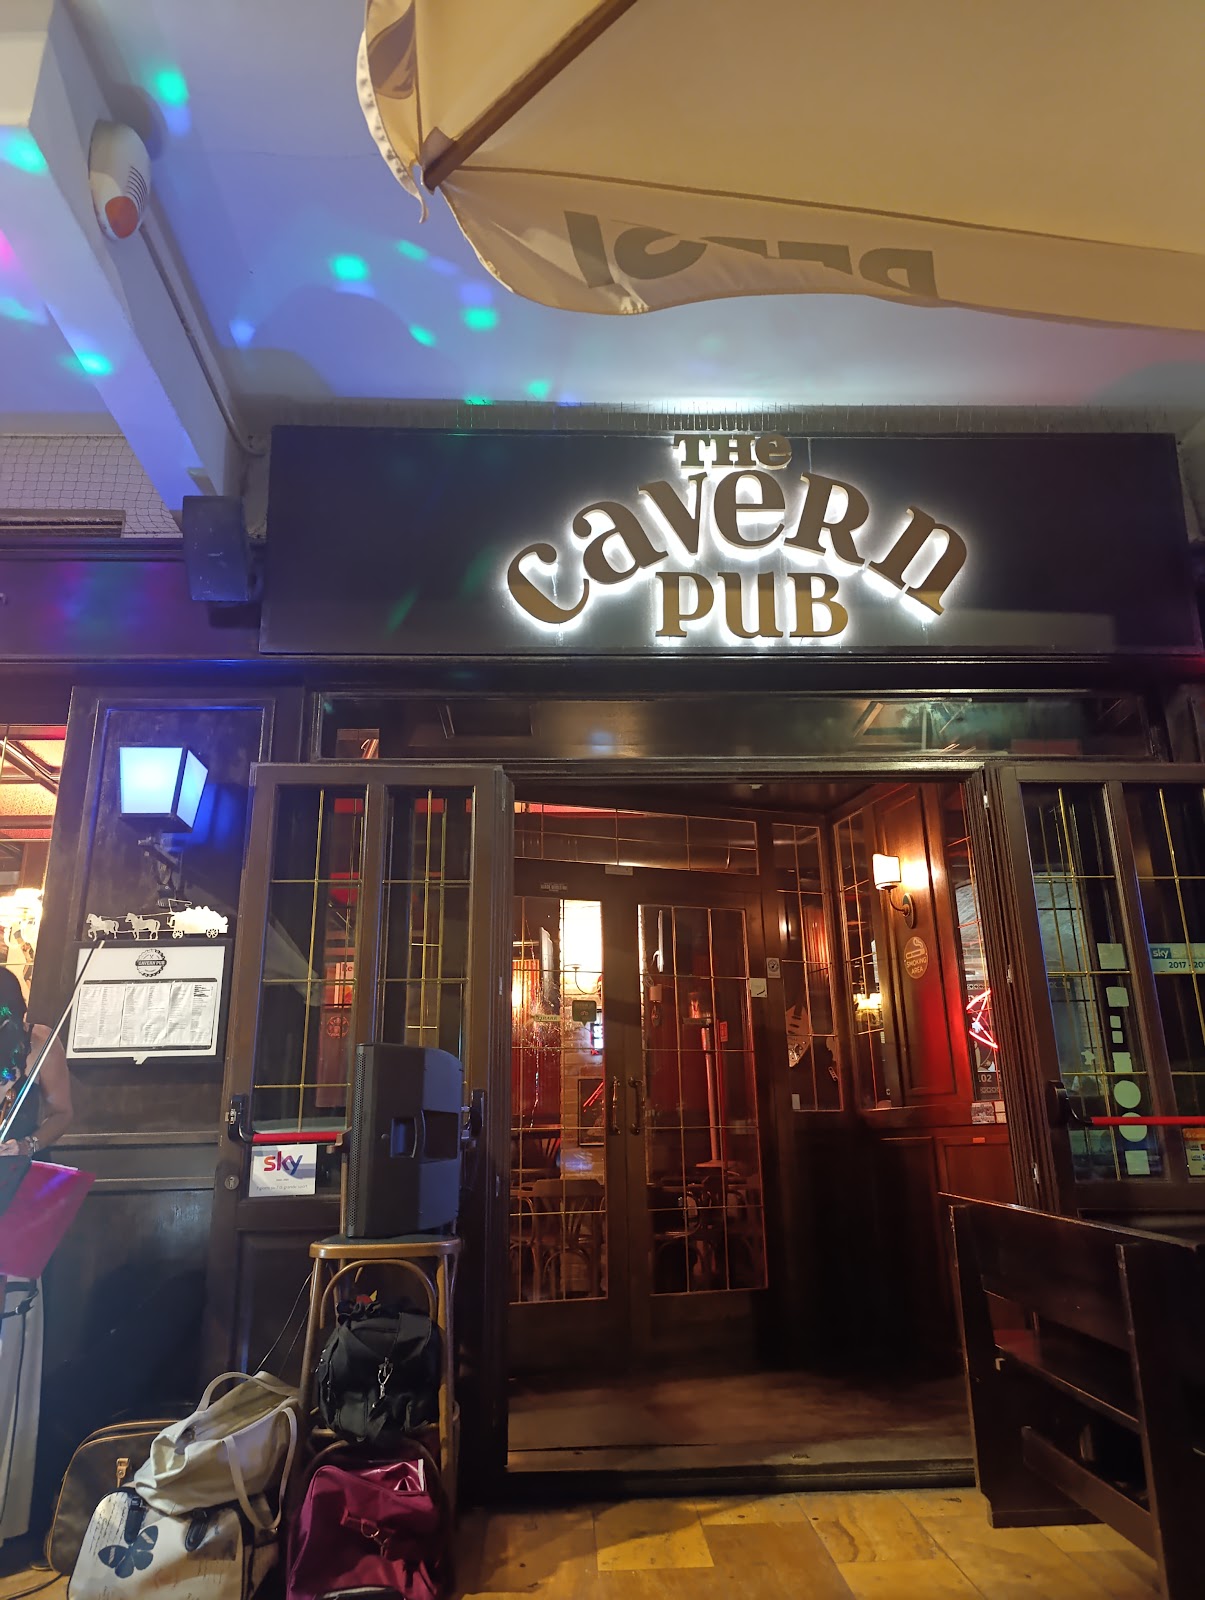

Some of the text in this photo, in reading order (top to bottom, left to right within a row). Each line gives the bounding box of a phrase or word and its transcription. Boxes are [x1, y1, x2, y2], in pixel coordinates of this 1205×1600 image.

[1152, 949, 1169, 959] sky
[906, 956, 927, 968] SMOKING
[1169, 961, 1187, 969] 2017
[911, 966, 924, 975] AREA
[264, 1151, 303, 1175] sky
